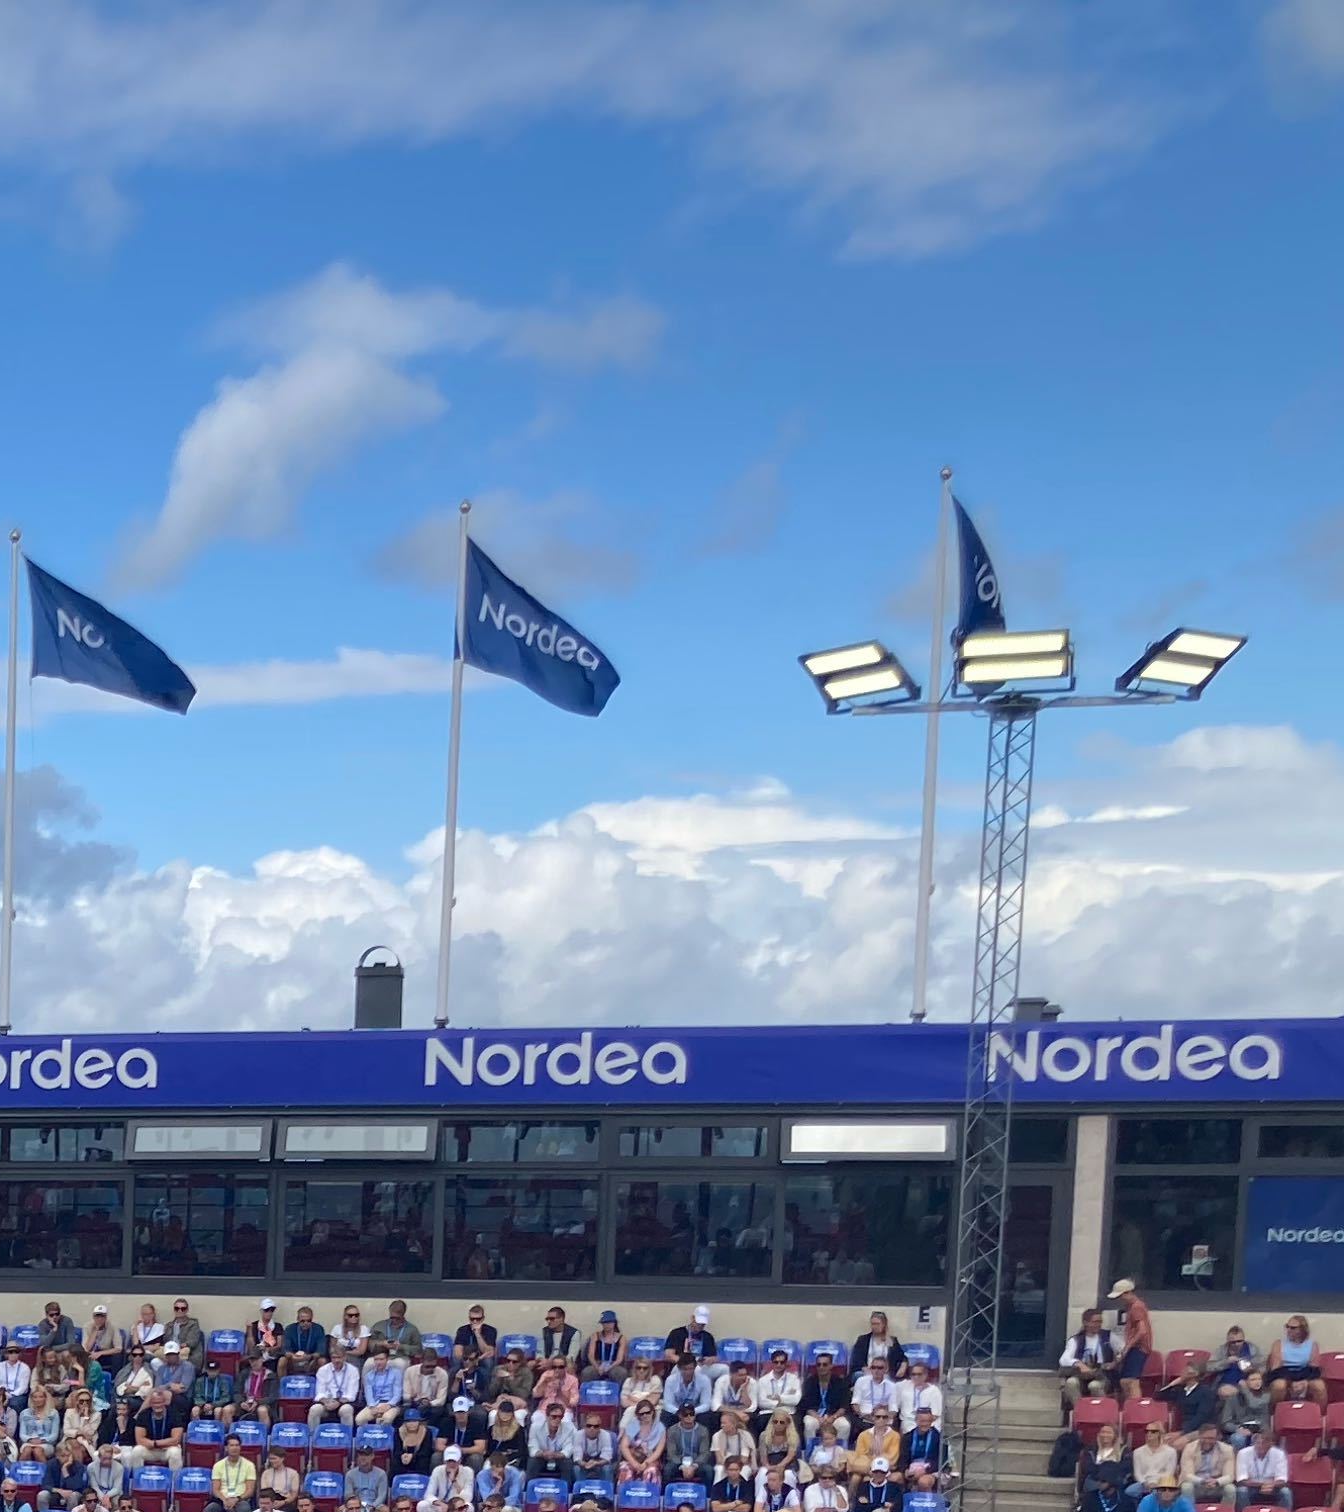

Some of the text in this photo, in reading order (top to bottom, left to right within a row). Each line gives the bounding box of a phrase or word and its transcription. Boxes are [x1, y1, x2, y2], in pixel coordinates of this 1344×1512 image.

[478, 593, 600, 671] Nordea
[425, 1031, 688, 1087] Nordea
[984, 1024, 1282, 1082] Nordea
[1267, 1226, 1344, 1243] Nordea
